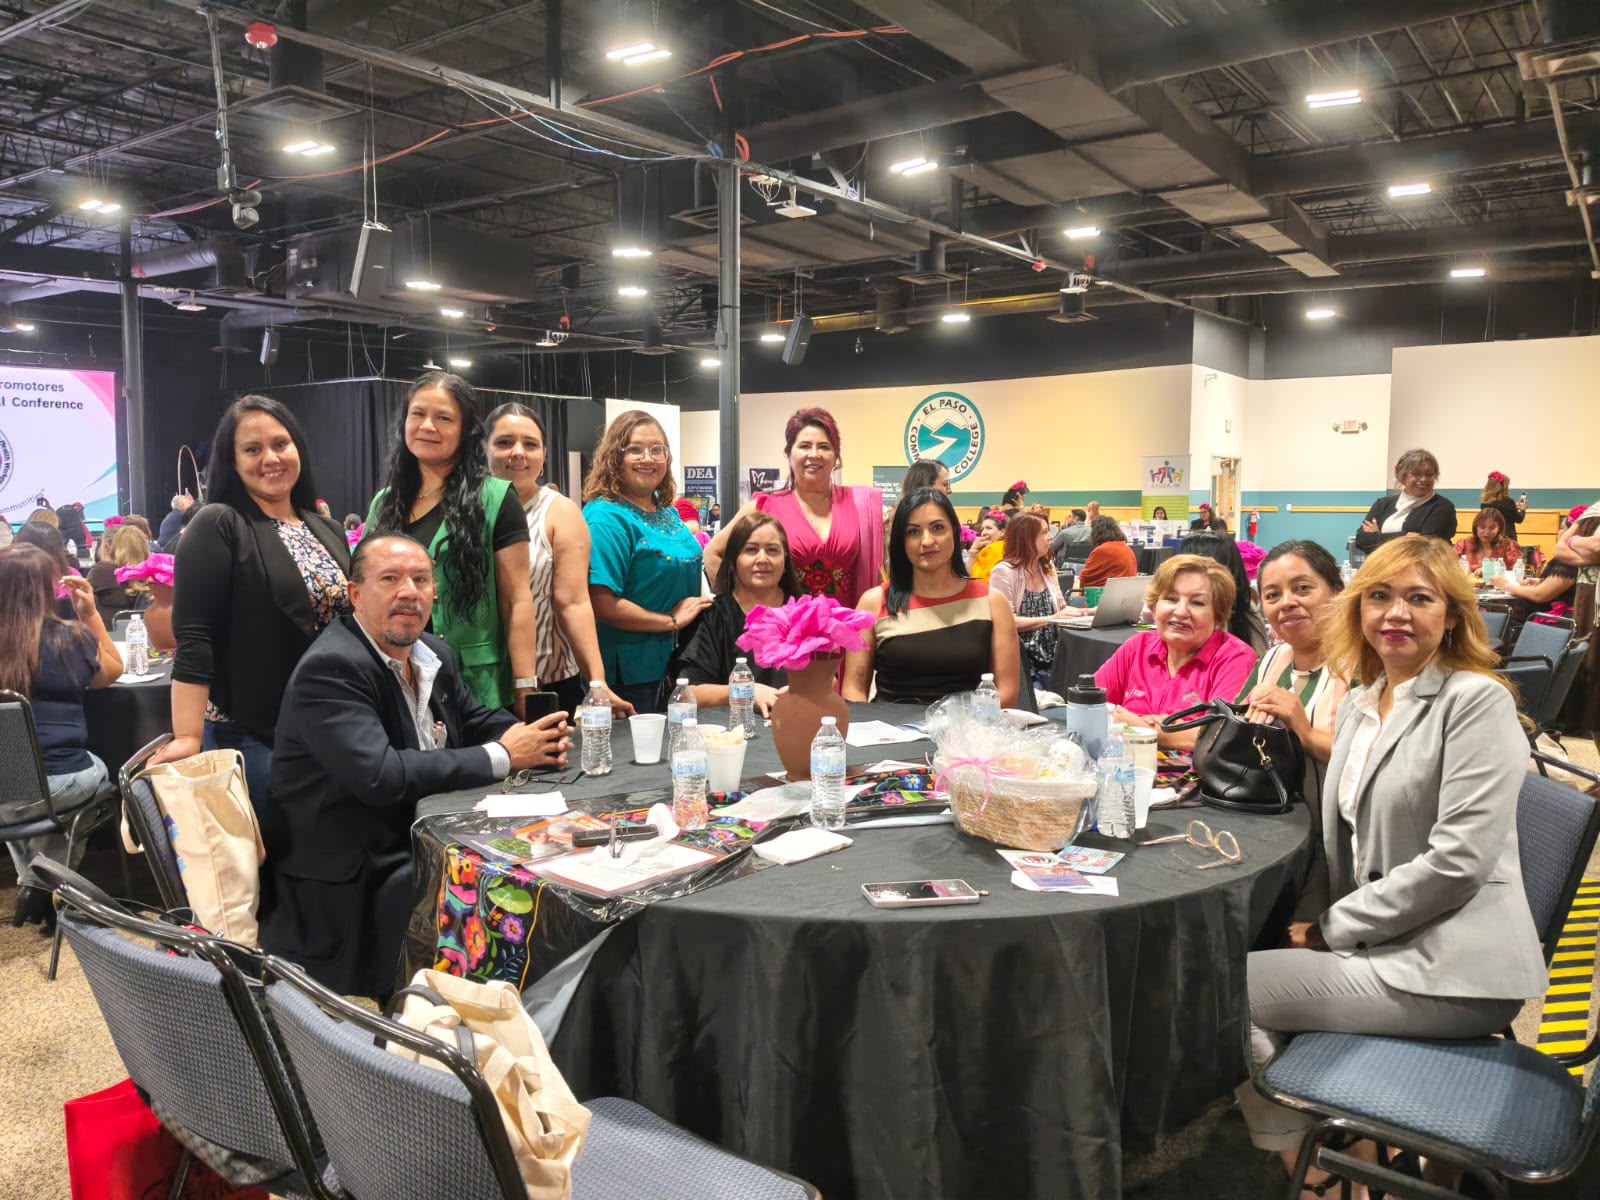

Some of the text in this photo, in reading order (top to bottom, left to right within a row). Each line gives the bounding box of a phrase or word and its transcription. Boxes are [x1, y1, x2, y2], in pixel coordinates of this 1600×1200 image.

[12, 397, 84, 410] Conference
[922, 399, 967, 416] EL PASO
[954, 422, 979, 474] COLLEGE
[687, 468, 714, 479] DEA
